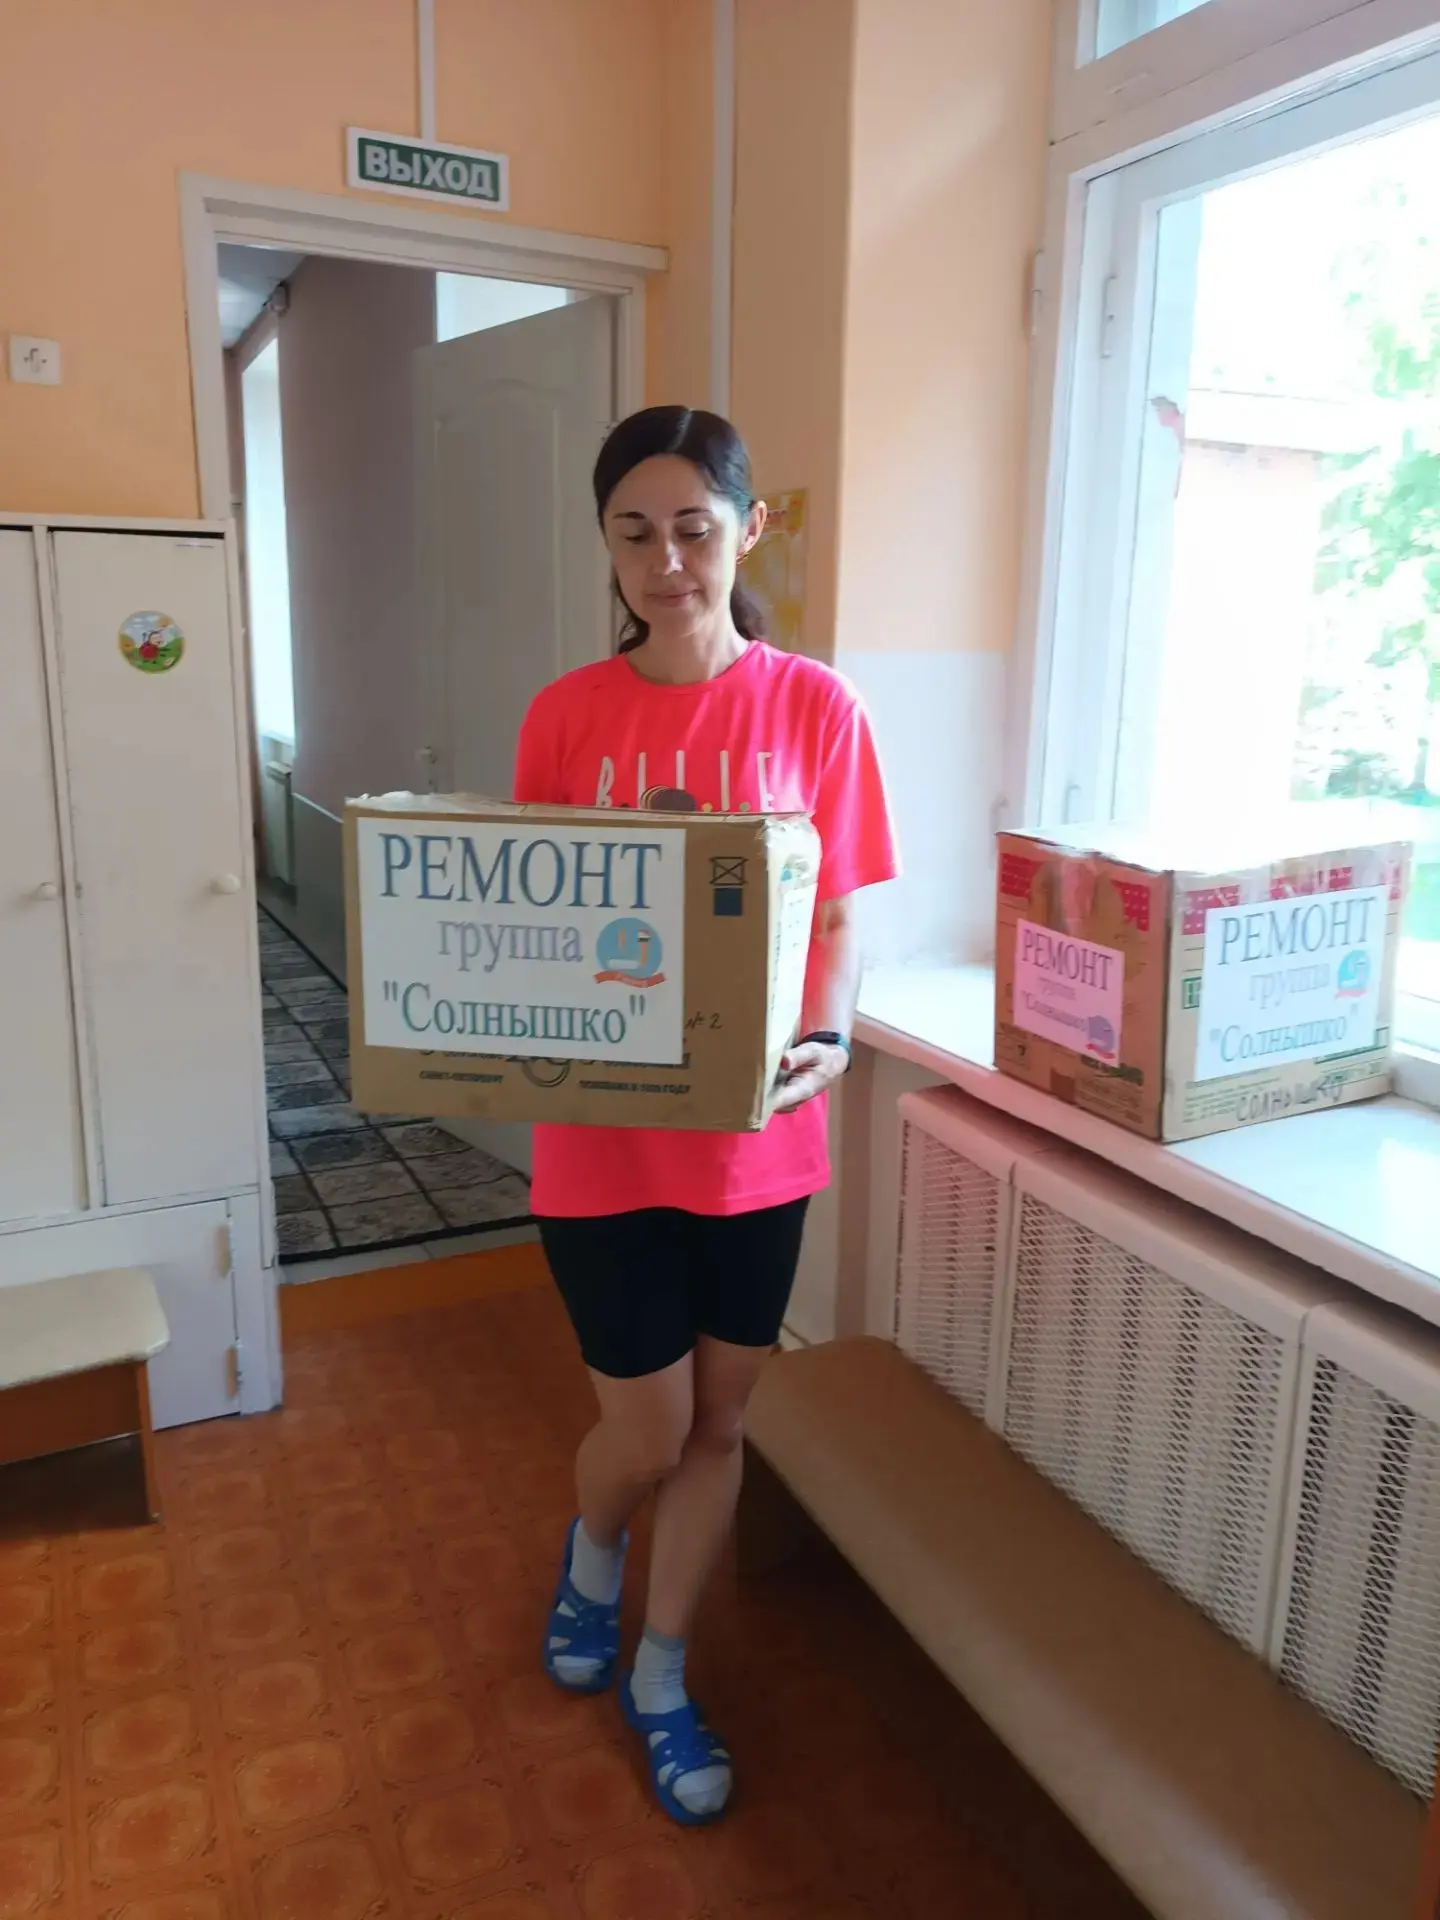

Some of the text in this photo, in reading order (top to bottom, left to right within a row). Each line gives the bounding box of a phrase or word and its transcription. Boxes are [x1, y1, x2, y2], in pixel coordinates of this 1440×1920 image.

[364, 145, 494, 198] ВЫХОД
[377, 833, 662, 909] РЕМОНТ
[437, 920, 584, 973] группа
[1022, 929, 1113, 990] РЕМОНТ
[1218, 896, 1377, 965] РЕМОНТ
[383, 980, 646, 1044] "Солнышко"
[709, 1012, 723, 1029] 2
